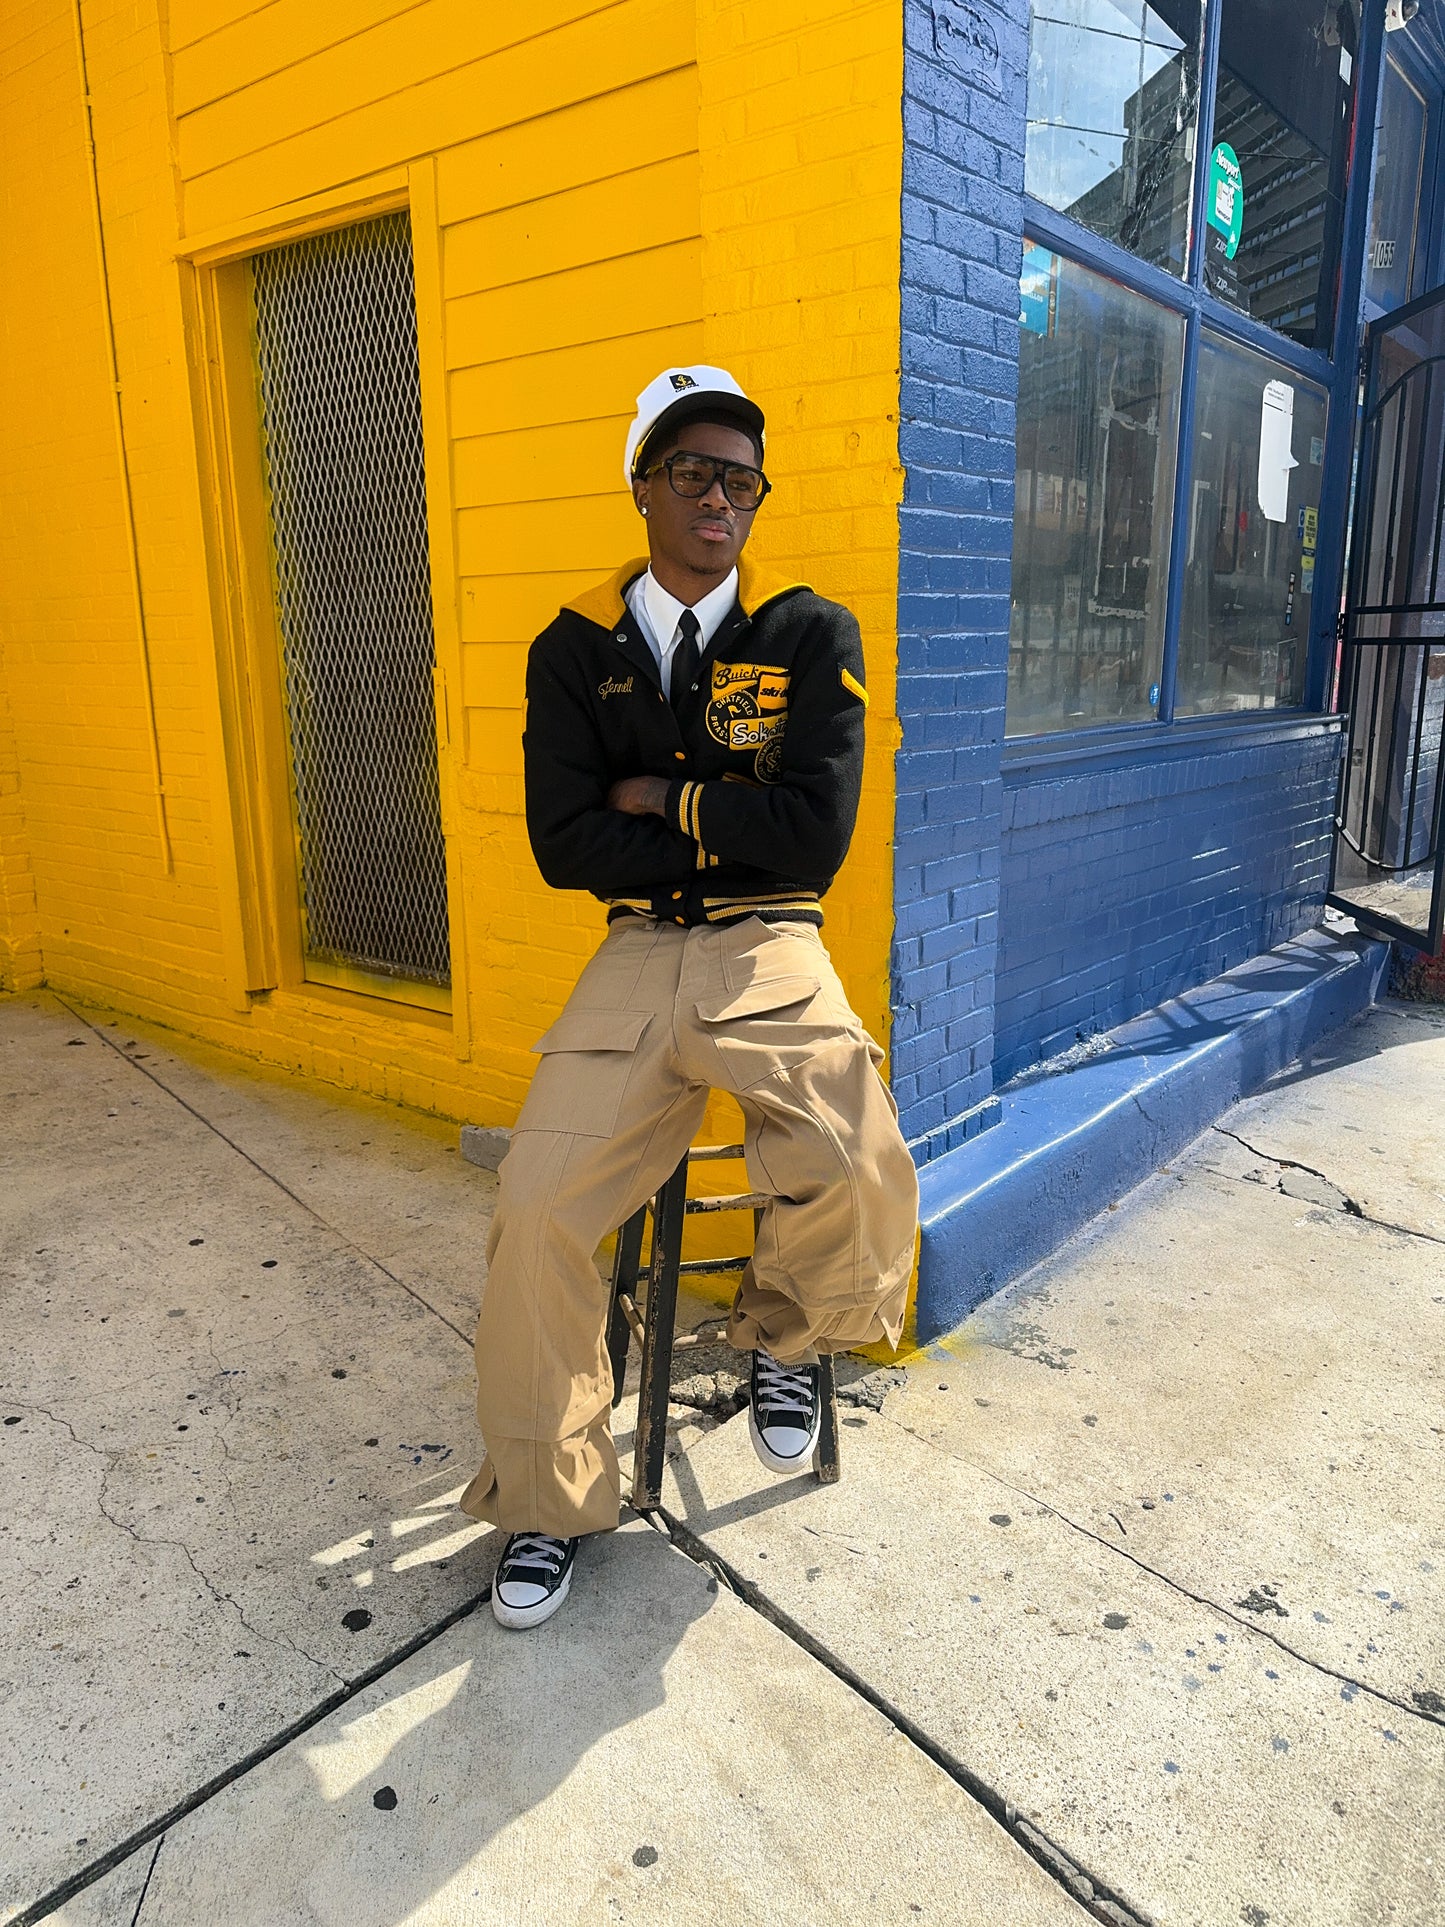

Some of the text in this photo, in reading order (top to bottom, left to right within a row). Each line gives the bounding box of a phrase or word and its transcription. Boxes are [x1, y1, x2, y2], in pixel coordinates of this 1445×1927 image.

[1215, 147, 1239, 180] Newport
[1374, 242, 1395, 267] 1055
[713, 666, 760, 689] Buick
[715, 694, 754, 717] CHATFIELD
